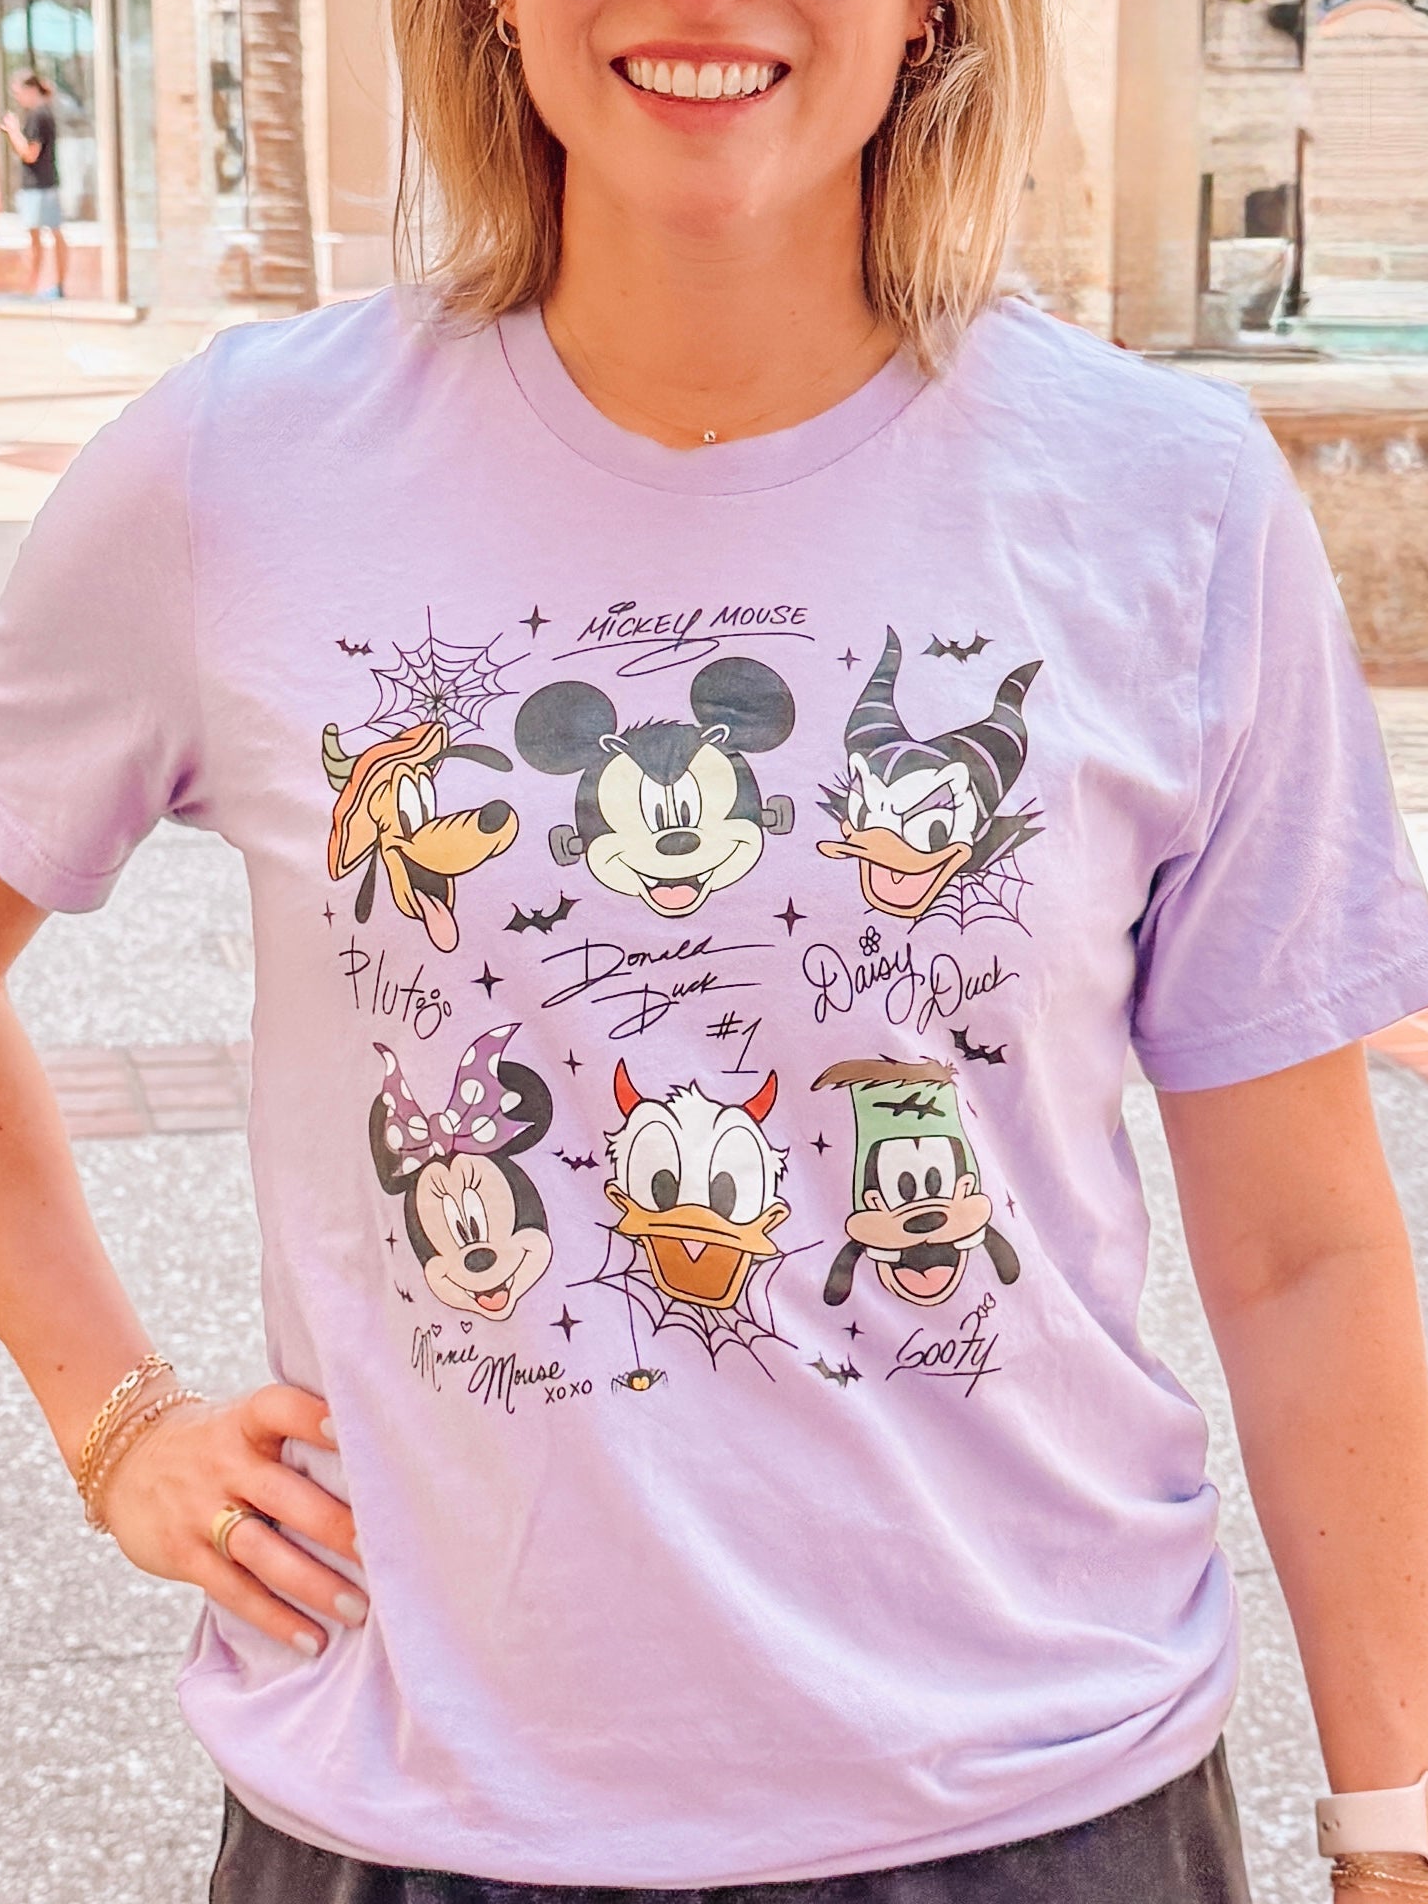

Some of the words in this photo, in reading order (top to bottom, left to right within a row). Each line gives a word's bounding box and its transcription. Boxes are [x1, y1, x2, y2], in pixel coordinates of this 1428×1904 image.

[709, 605, 809, 628] MOUSE
[338, 934, 452, 1040] Pluto
[541, 936, 775, 1009] Donald
[590, 971, 763, 1039] Duck
[802, 925, 926, 1025] Daisy
[917, 953, 1020, 1036] Duck
[705, 1010, 763, 1074] #1
[468, 1352, 566, 1415] Mouse
